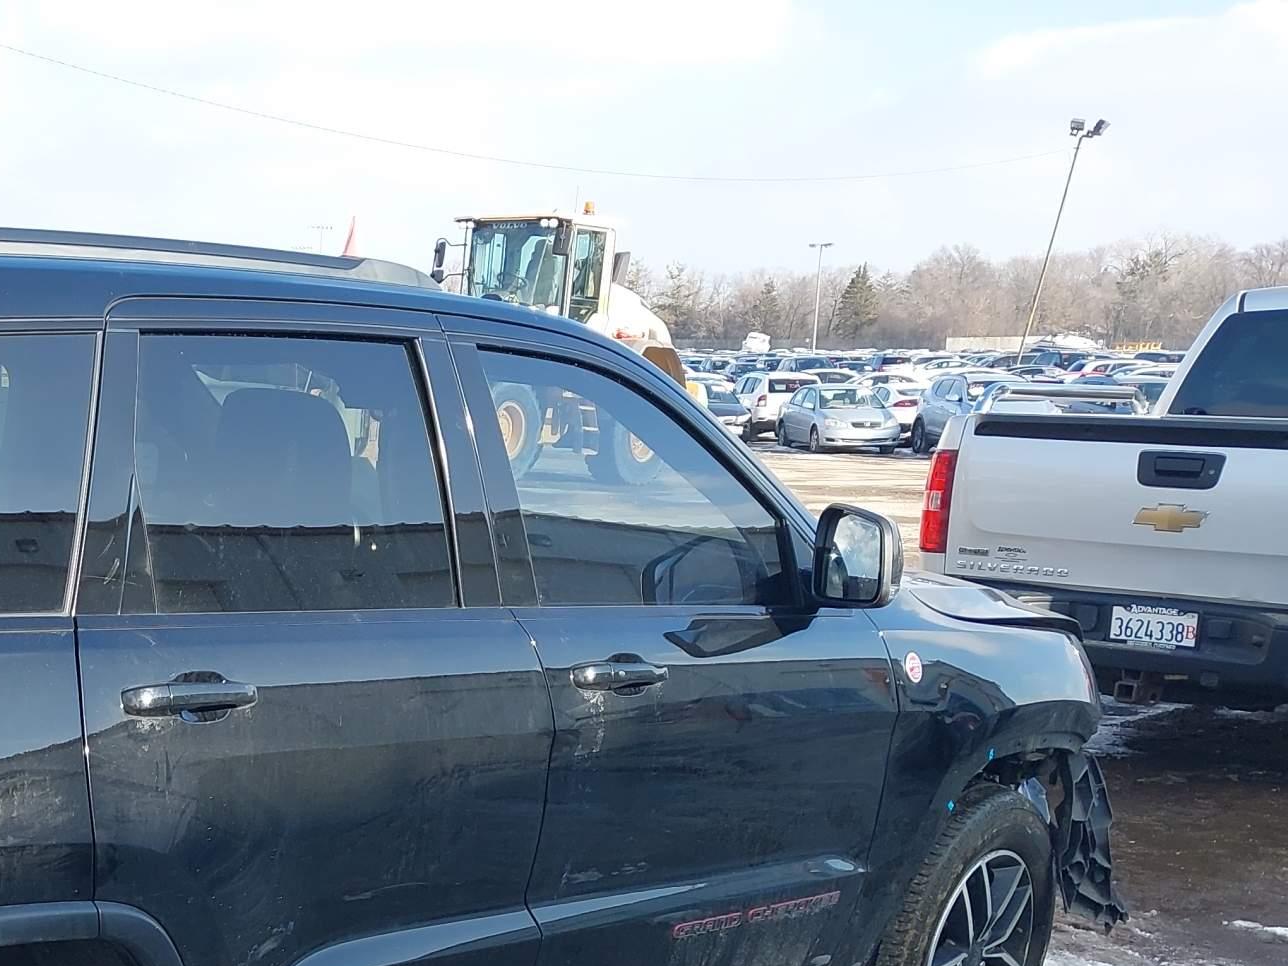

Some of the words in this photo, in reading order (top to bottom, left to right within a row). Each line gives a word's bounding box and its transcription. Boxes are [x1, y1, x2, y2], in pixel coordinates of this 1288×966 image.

[956, 560, 1069, 577] SILVERADO
[1131, 604, 1179, 616] ADVANTAGE
[673, 912, 742, 938] GRAND
